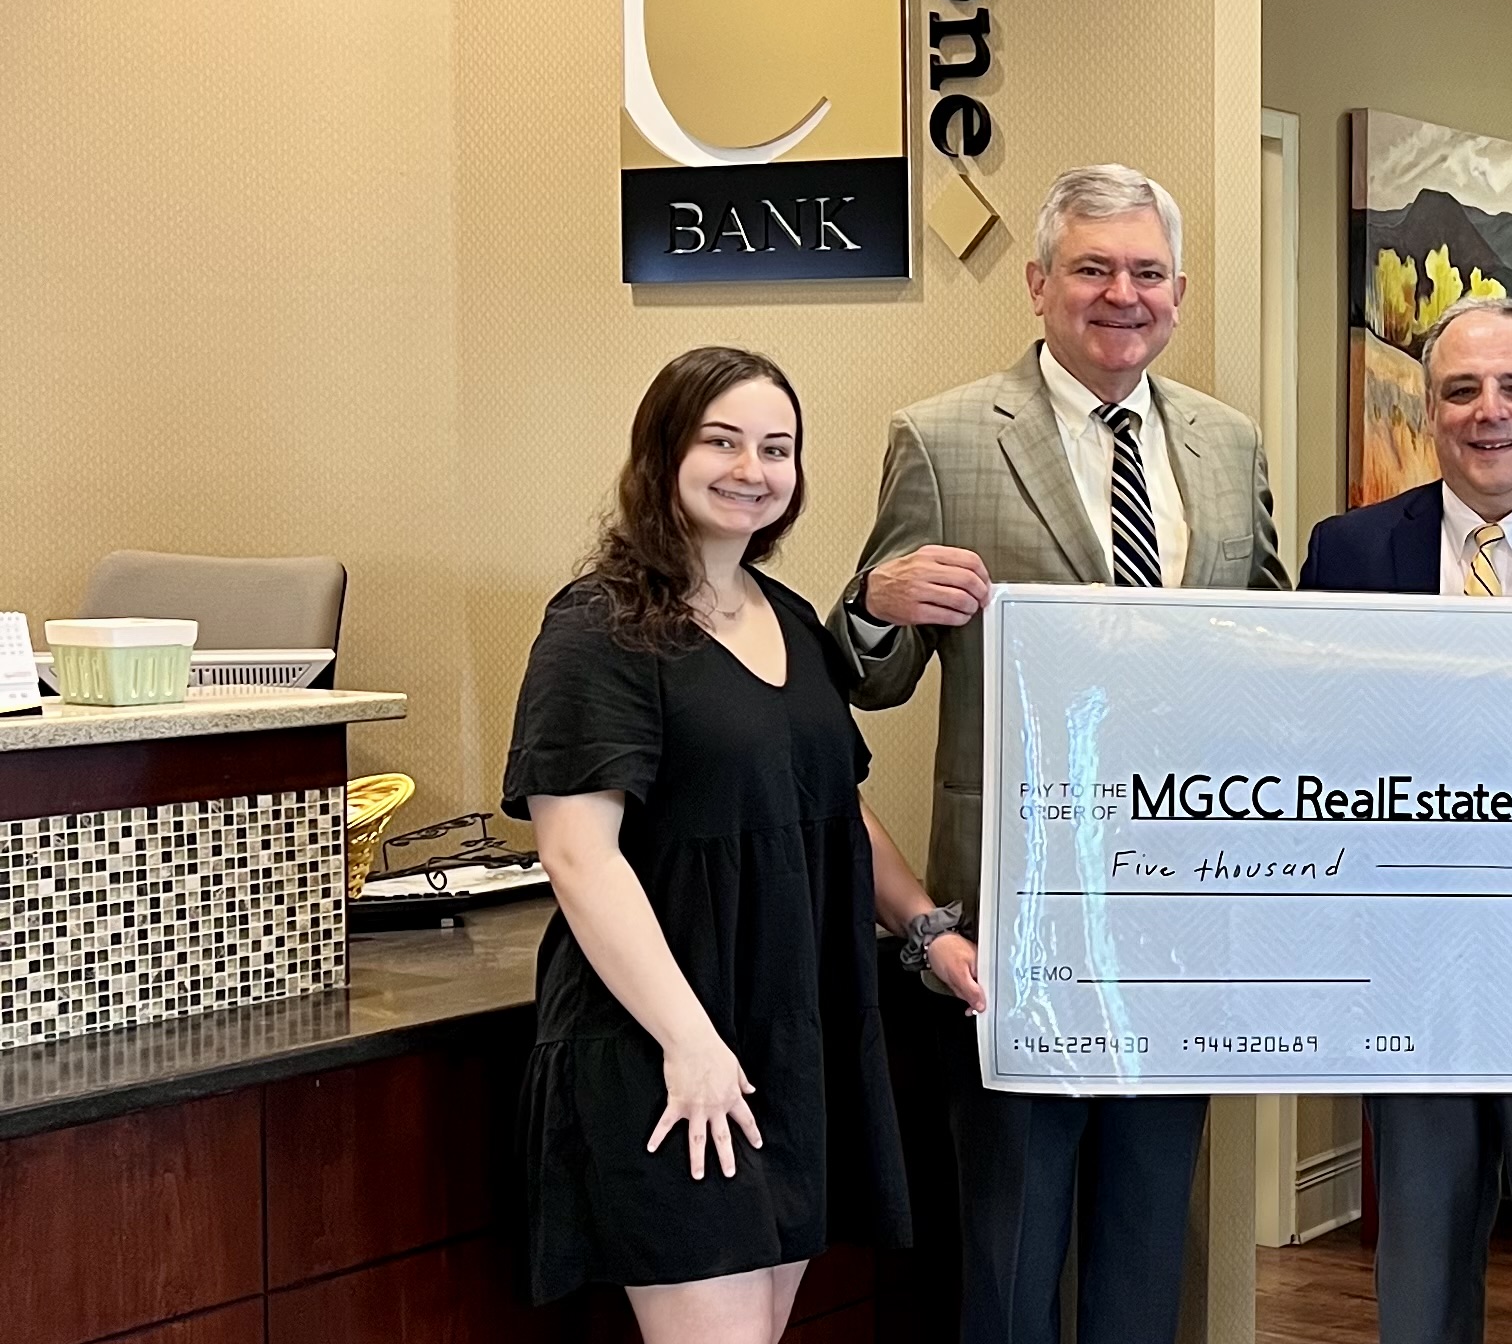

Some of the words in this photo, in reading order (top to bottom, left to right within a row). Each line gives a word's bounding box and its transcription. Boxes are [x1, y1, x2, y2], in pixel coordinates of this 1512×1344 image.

[667, 196, 862, 255] BANK
[1060, 783, 1084, 798] TO
[1092, 783, 1128, 798] THE
[1132, 773, 1282, 820] MGCC
[1296, 775, 1512, 821] RealEstate
[1092, 806, 1118, 821] OF
[1112, 850, 1175, 879] Five
[1194, 848, 1345, 880] thousand
